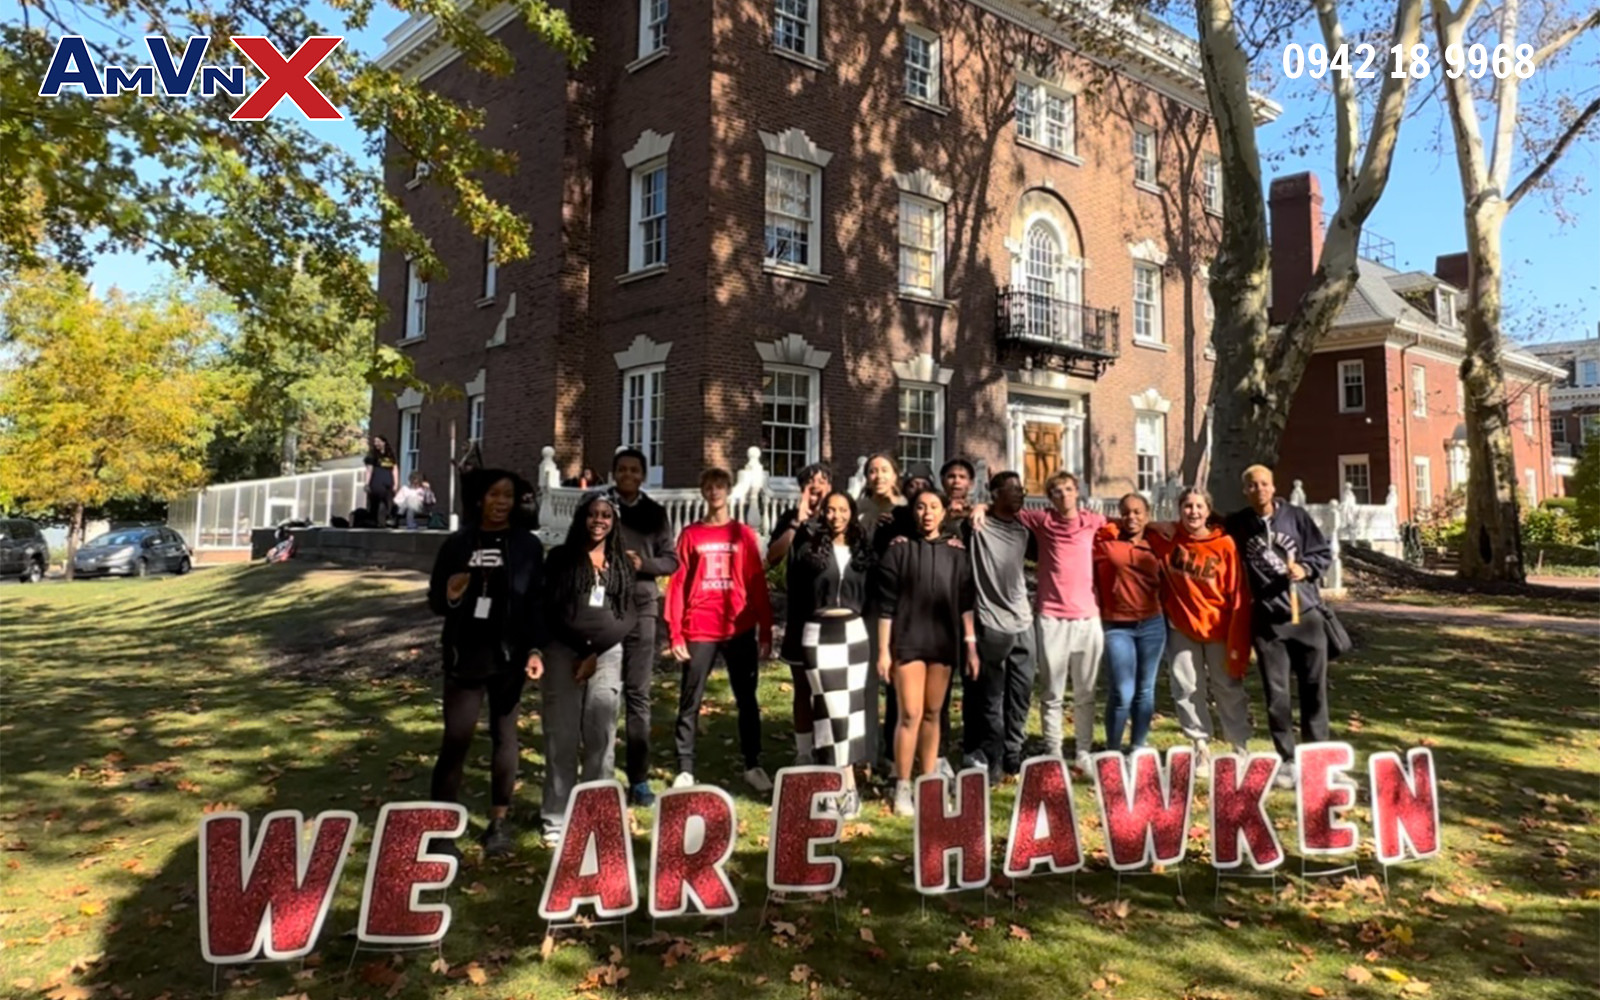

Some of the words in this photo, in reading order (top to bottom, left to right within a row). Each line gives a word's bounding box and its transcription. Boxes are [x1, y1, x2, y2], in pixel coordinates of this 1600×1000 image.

[704, 553, 732, 579] H
[199, 802, 468, 964] WE
[538, 765, 846, 920] ARE
[914, 741, 1441, 893] HAWKEN
